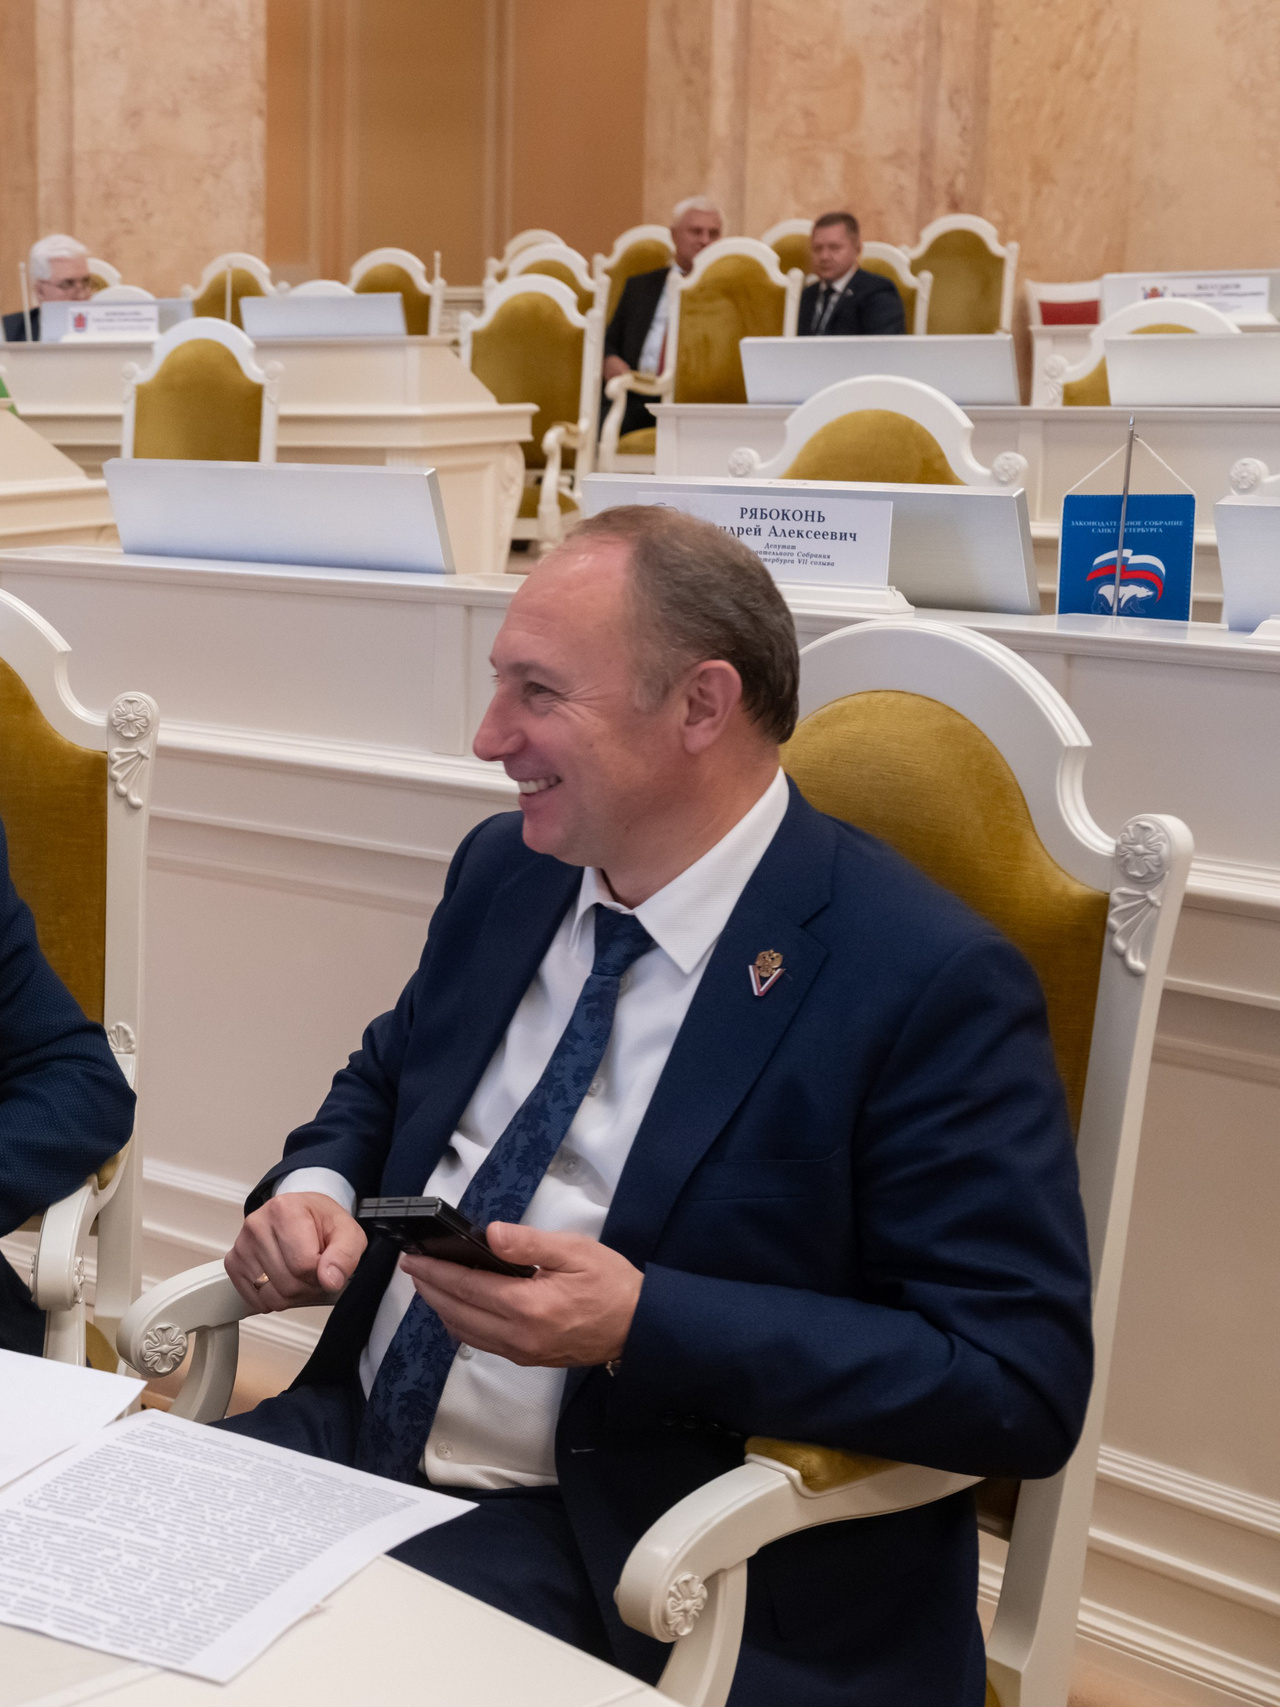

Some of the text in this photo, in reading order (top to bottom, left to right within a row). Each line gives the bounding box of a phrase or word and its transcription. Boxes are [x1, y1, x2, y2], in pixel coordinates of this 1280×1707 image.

[739, 507, 826, 523] РЯБОКОНЬ
[767, 525, 858, 542] Алексеевич
[764, 542, 797, 550] Депутат
[796, 551, 831, 559] Собрания
